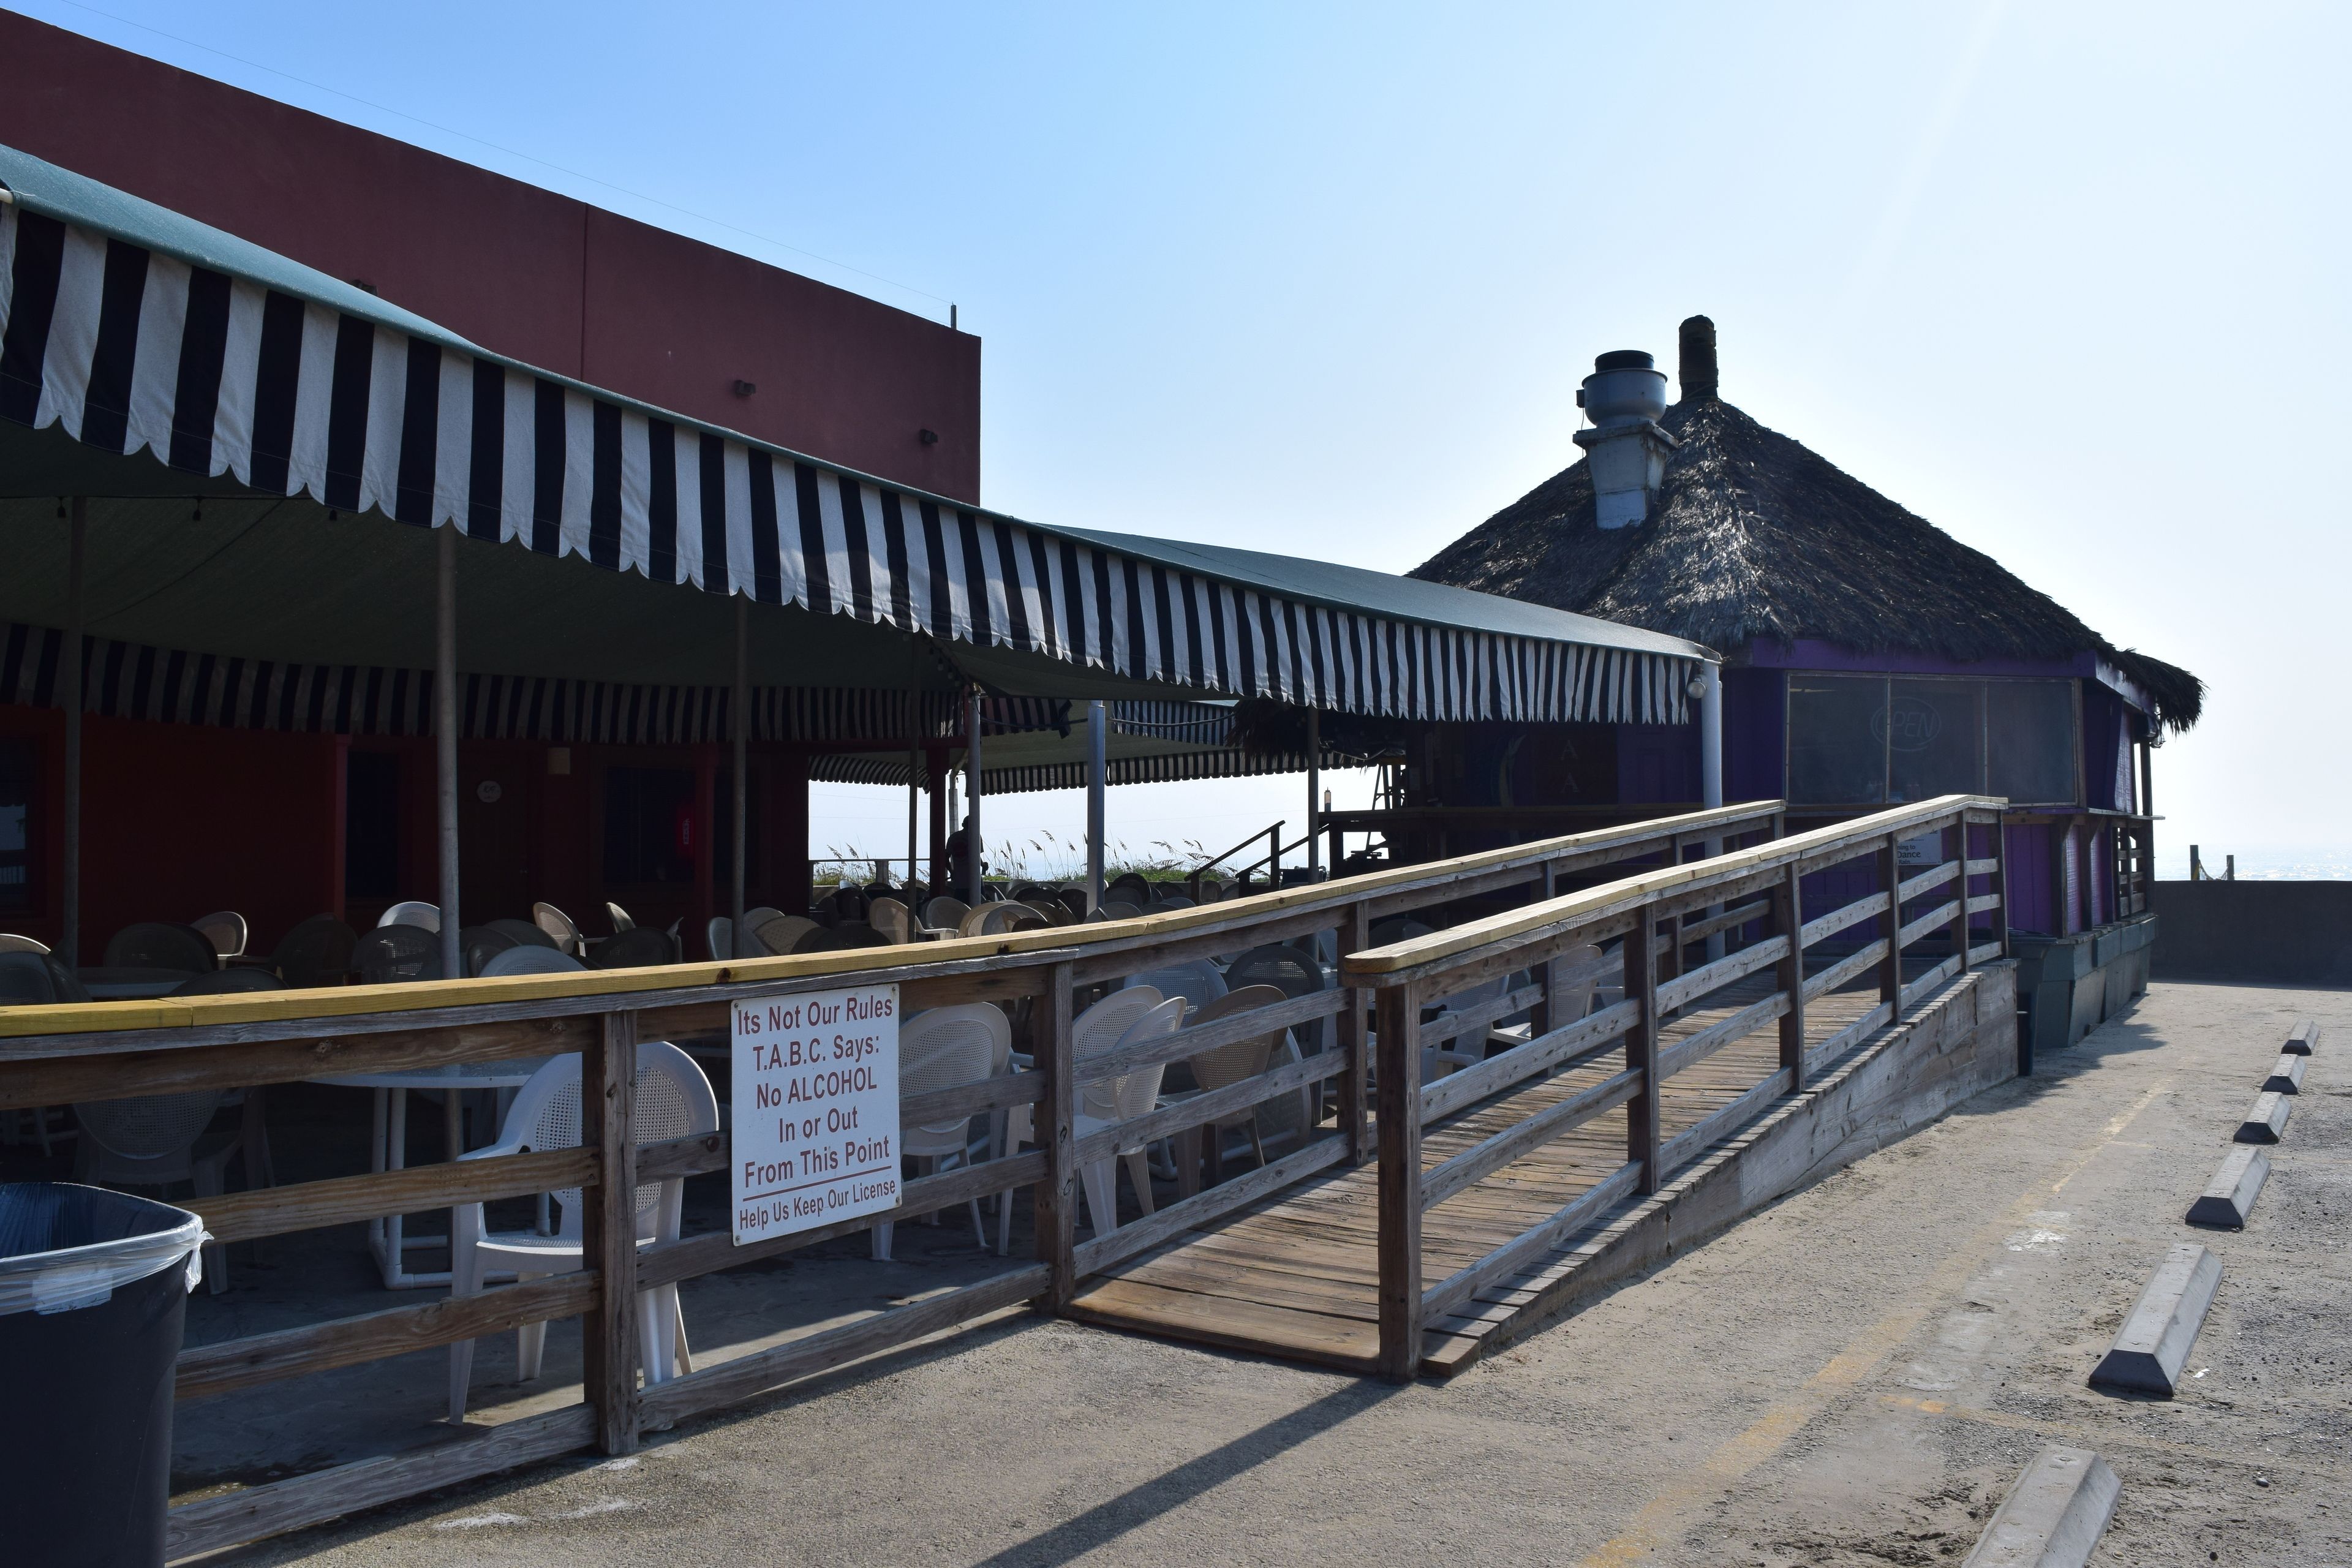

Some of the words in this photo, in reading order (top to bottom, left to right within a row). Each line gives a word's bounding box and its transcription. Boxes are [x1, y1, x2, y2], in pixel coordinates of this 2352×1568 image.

[737, 1009, 761, 1036] Its
[769, 1005, 801, 1031] Not
[807, 1001, 840, 1027] Our
[846, 995, 892, 1022] Rules
[753, 1038, 826, 1071] T.A.B.C.
[833, 1035, 879, 1063] Says:
[757, 1082, 782, 1109] No
[788, 1066, 877, 1104] ALCOHOL
[779, 1118, 795, 1143] In
[802, 1117, 821, 1139] or
[827, 1105, 858, 1133] Out
[745, 1160, 793, 1188] From
[800, 1146, 839, 1175] This
[845, 1135, 890, 1166] Point
[739, 1206, 769, 1231] Help
[773, 1201, 790, 1222] Us
[794, 1196, 824, 1218] Keep
[827, 1189, 849, 1209] Our
[853, 1180, 897, 1204] License
